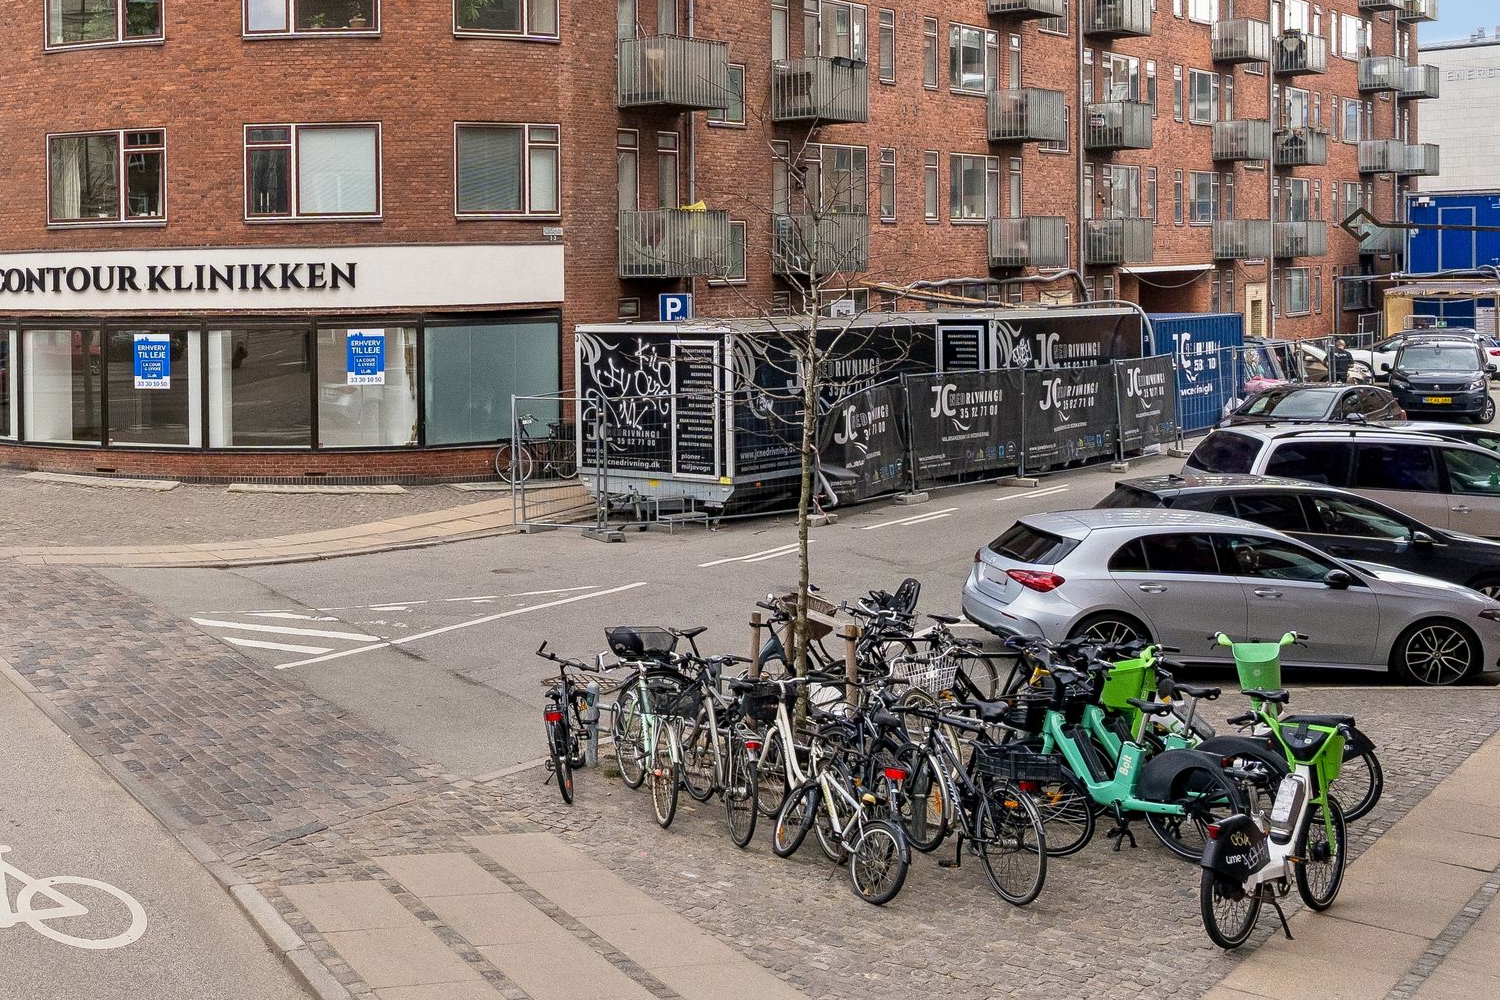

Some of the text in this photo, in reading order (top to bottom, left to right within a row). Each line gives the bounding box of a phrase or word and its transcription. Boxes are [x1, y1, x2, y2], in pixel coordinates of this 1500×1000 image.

[146, 262, 359, 291] KLINIKKEN
[350, 339, 381, 347] ERHVERV
[352, 346, 381, 354] TIL LEJE
[138, 351, 166, 359] TIL LEJE
[930, 383, 958, 418] JC
[1039, 378, 1061, 411] JC
